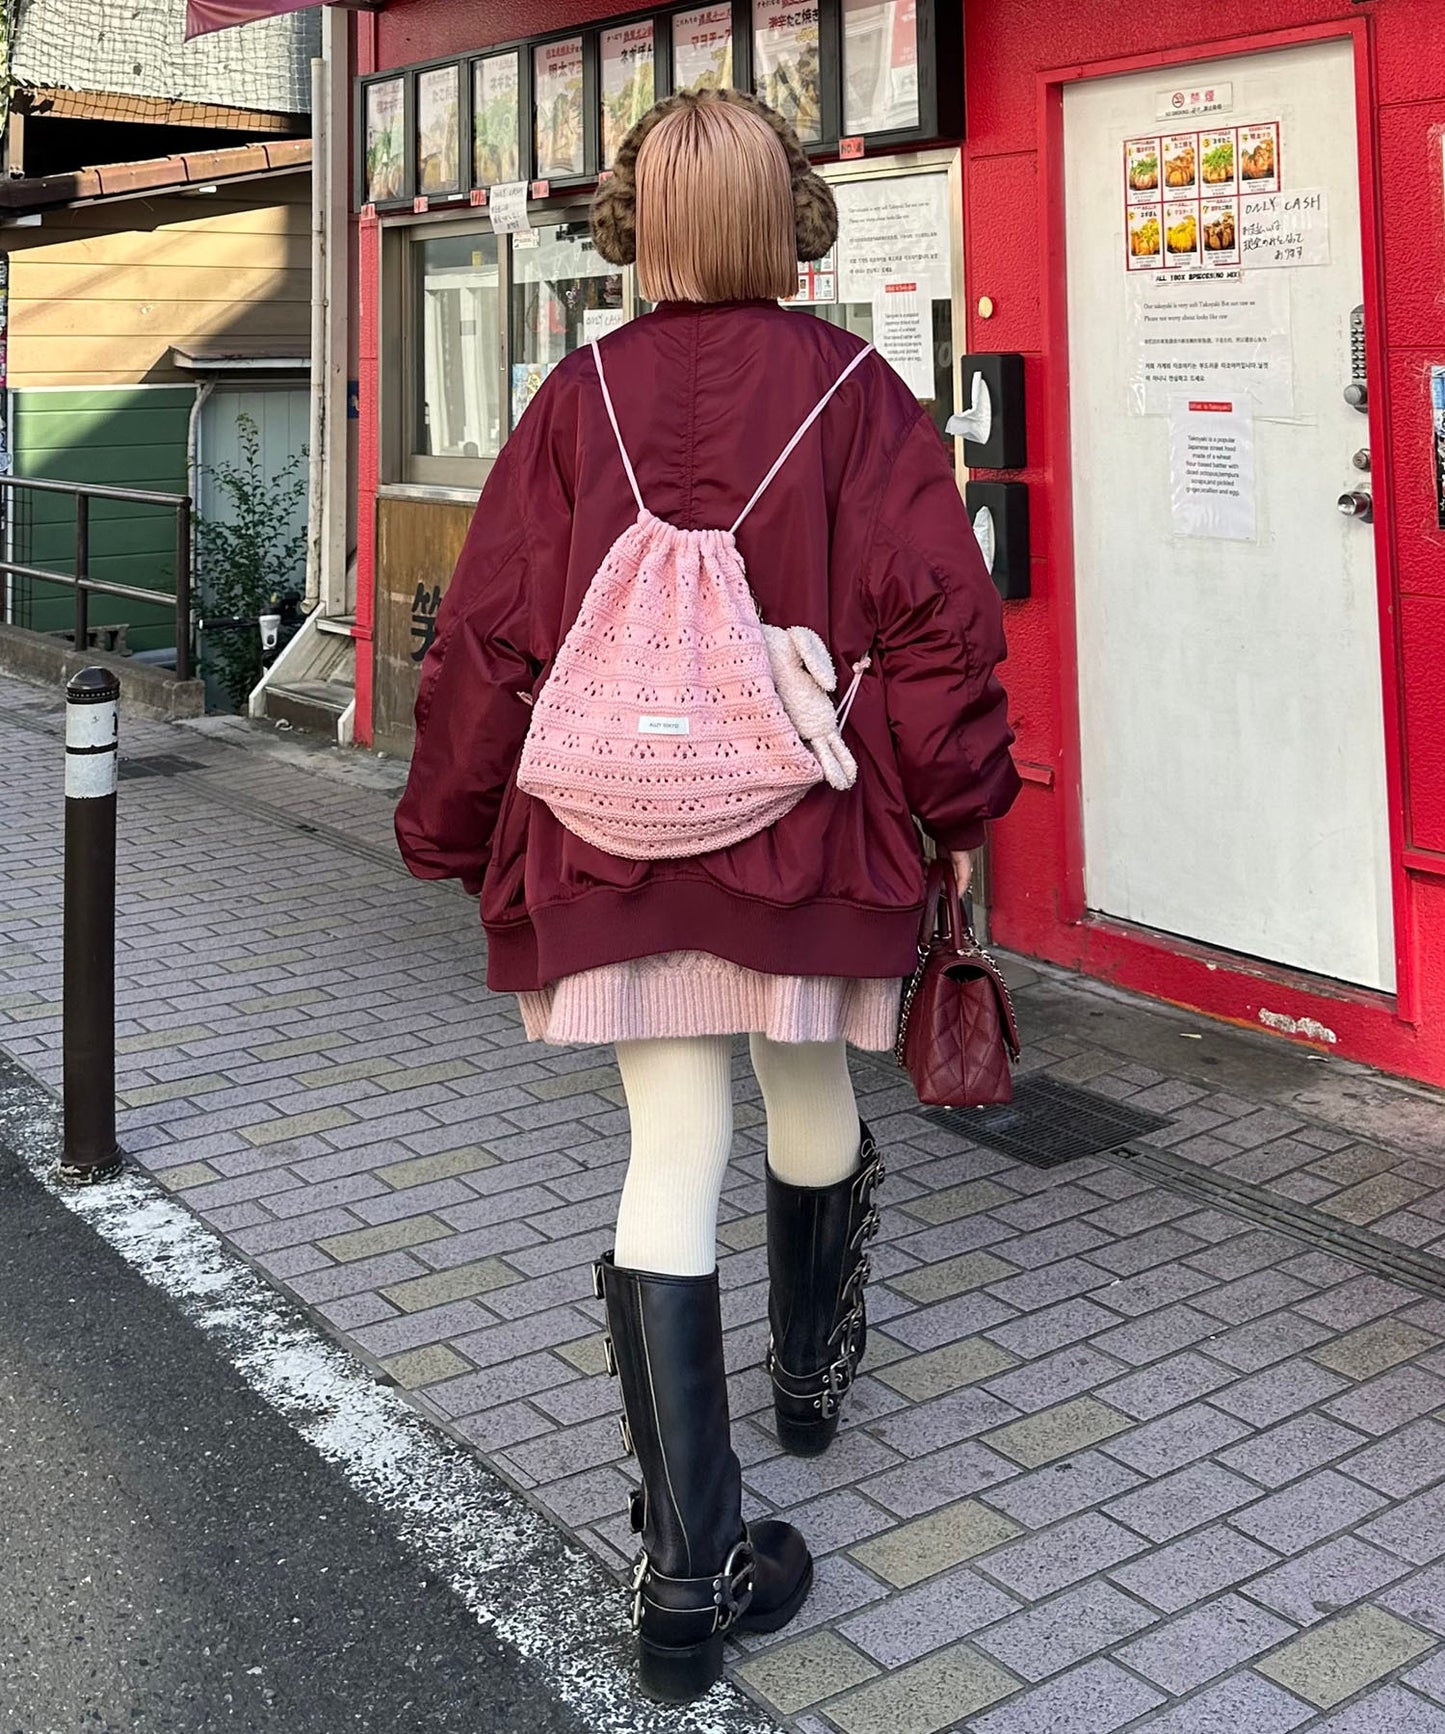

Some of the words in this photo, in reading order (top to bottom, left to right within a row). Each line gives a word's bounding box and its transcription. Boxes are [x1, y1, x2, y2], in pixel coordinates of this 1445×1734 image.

[1246, 197, 1277, 214] ONLY
[1284, 194, 1320, 211] CASH
[1217, 436, 1235, 444] popular
